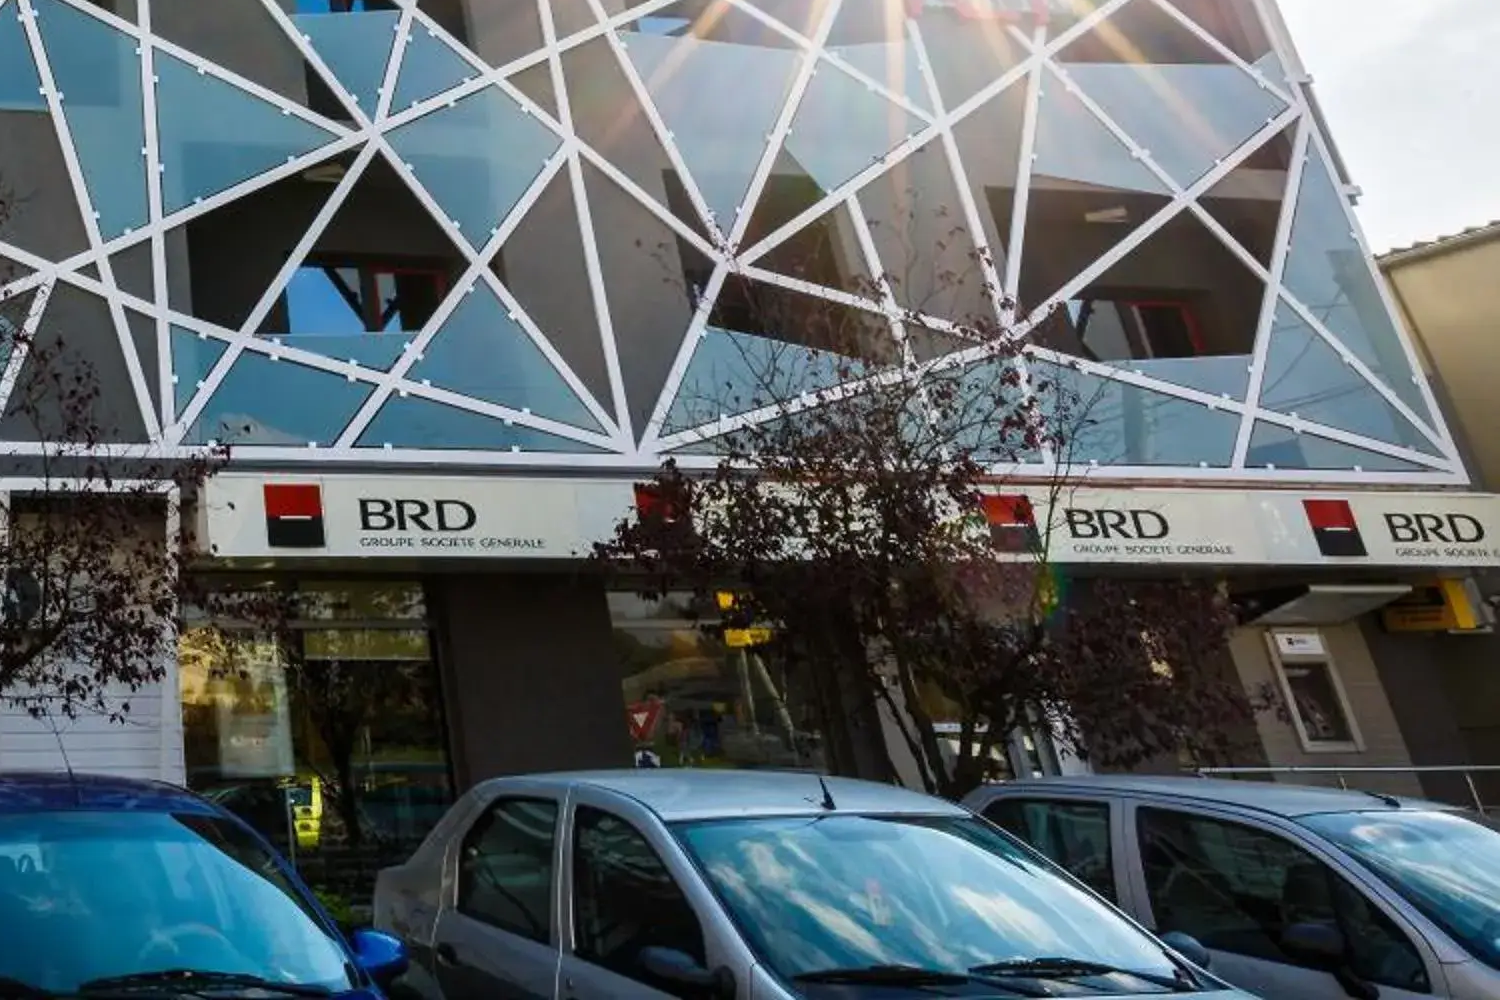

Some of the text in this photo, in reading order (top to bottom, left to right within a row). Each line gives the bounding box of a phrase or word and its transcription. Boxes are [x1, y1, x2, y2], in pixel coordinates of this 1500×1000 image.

[358, 498, 477, 531] BRD
[1064, 508, 1170, 539] BRD
[1384, 513, 1485, 542] BRD
[360, 537, 414, 548] GROUPE
